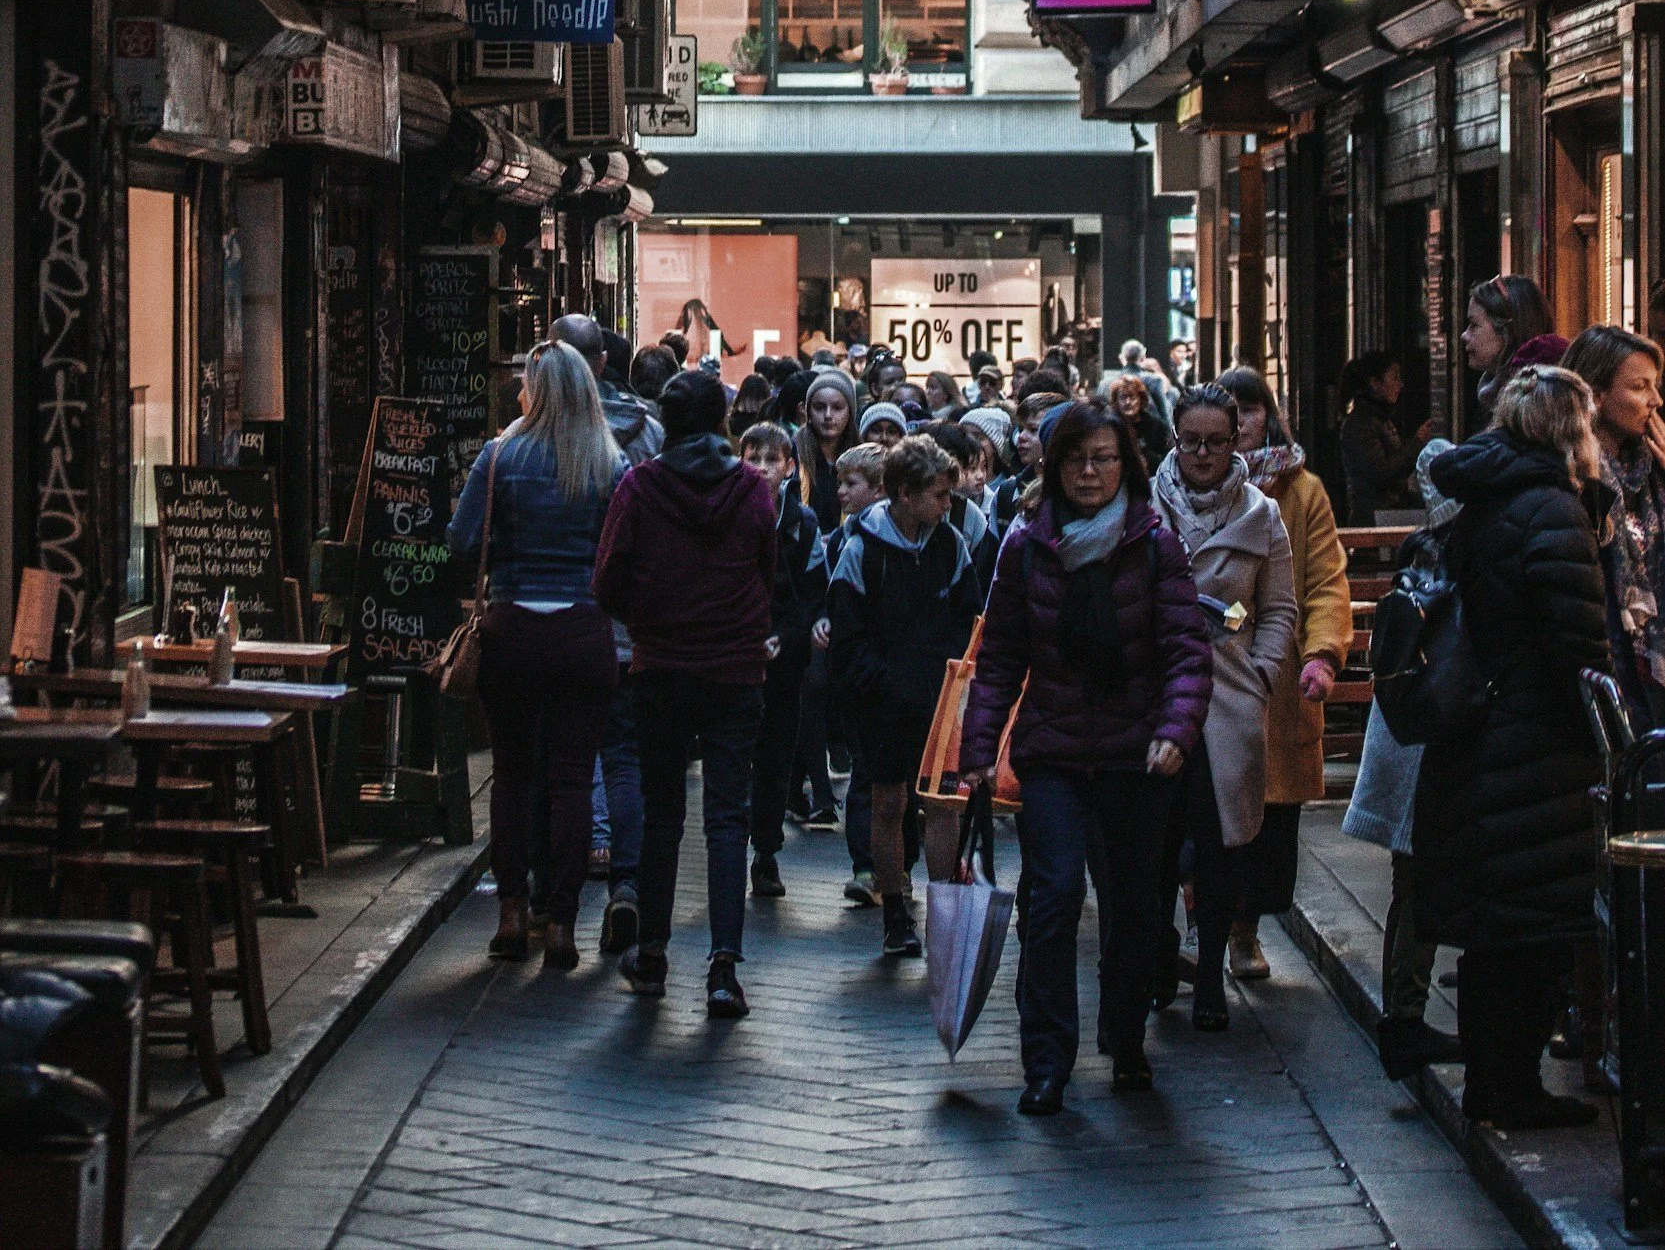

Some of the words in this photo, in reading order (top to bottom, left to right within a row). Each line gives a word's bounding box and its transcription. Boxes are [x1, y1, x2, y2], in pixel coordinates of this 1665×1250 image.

[668, 72, 689, 82] RED
[934, 273, 954, 293] UP
[958, 273, 978, 293] TO
[889, 319, 952, 361] 50%
[961, 319, 1023, 361] OFF
[373, 478, 430, 507] PANINIS
[362, 596, 377, 629] 8
[381, 608, 424, 638] FRESH
